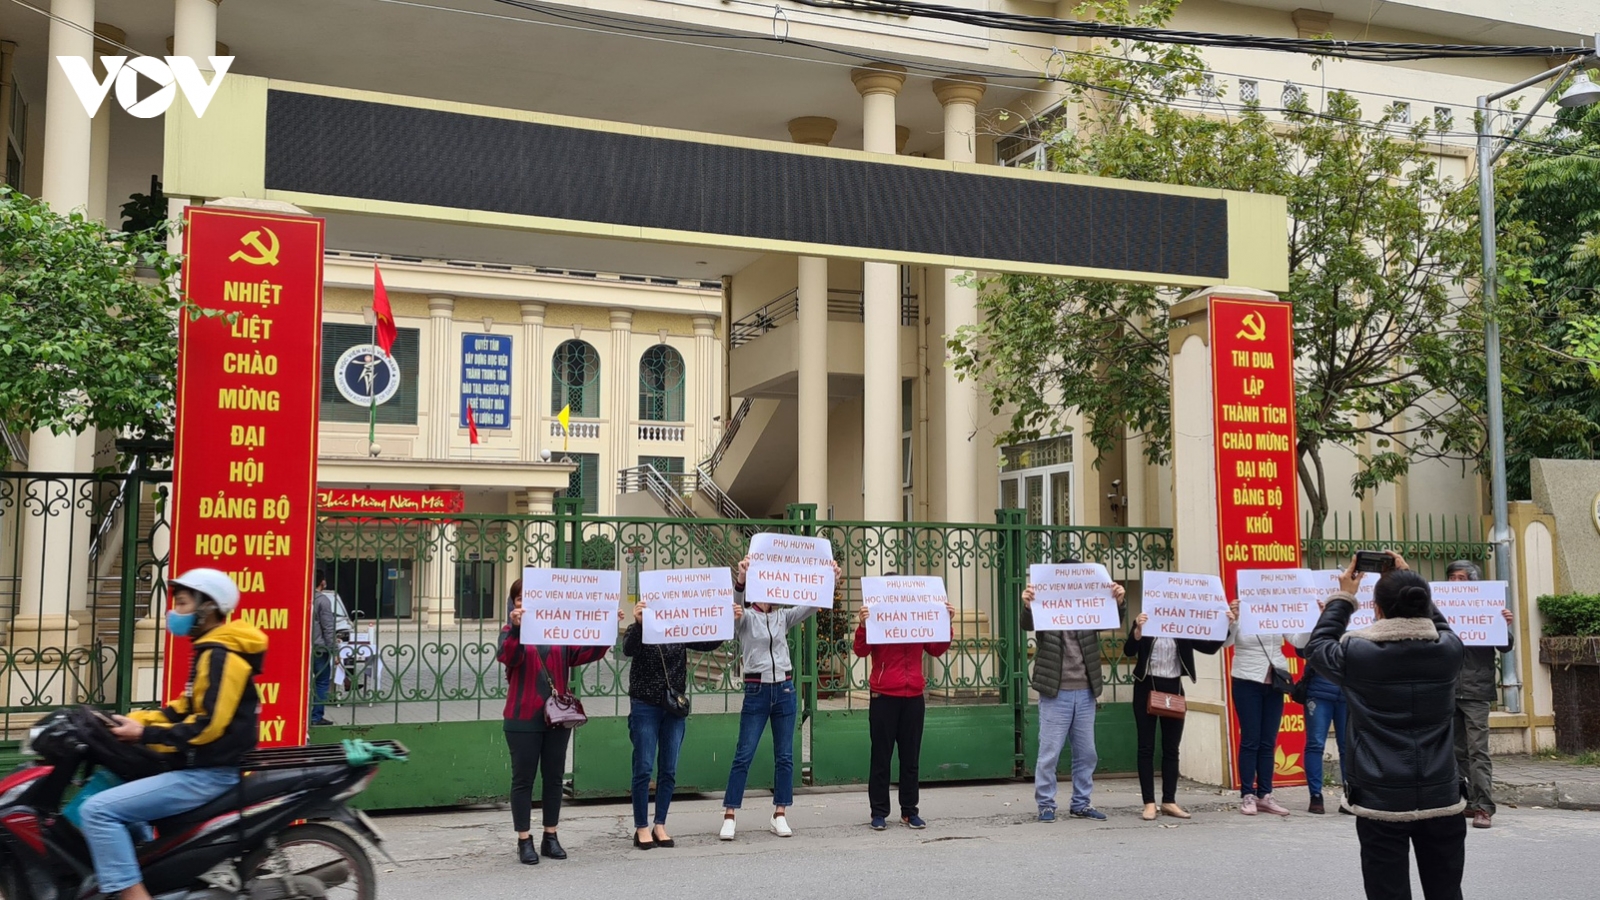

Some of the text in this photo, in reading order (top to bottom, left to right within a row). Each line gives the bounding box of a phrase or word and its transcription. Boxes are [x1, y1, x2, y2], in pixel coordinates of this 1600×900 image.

[223, 280, 282, 308] NHIỆT
[231, 314, 272, 343] LIỆT
[223, 350, 277, 375] CHÀO
[1232, 350, 1274, 369] THI ĐUA
[1243, 376, 1264, 399] LẬP
[218, 385, 280, 412] MỪNG
[1222, 402, 1287, 424] THÀNH TÍCH
[230, 425, 265, 451] ĐẠI
[1222, 430, 1289, 451] CHÀO MỪNG
[229, 457, 264, 487] HỘI
[1236, 459, 1277, 480] ĐẠI HỘI
[1233, 483, 1282, 509] ĐẢNG BỘ
[199, 491, 290, 524] ĐẢNG BỘ
[390, 495, 418, 511] Năm
[1246, 512, 1272, 534] KHỐI
[195, 531, 290, 560] HỌC VIỆN
[773, 539, 815, 550] PHỤ HUYNH
[1226, 542, 1295, 563] CÁC TRƯỜNG
[766, 554, 783, 563] VIỆN
[784, 554, 800, 564] MÚA
[802, 557, 817, 566] VIỆT
[552, 574, 598, 585] PHỤ HUYNH
[667, 574, 710, 584] PHỤ HUYNH
[794, 573, 824, 584] THIẾT
[1055, 569, 1070, 578] PHỤ
[1261, 574, 1274, 582] PHỤ
[887, 581, 901, 589] PHỤ
[1049, 583, 1066, 592] VIỆN
[1084, 582, 1099, 591] VIỆT
[1168, 577, 1209, 586] PHỤ HUYNH
[525, 590, 542, 599] HỌC
[545, 590, 563, 600] VIỆN
[566, 590, 583, 600] MÚA
[586, 591, 603, 602] VIỆT
[642, 592, 659, 602] HỌC
[662, 590, 679, 600] VIỆN
[682, 588, 698, 597] MÚA
[700, 588, 716, 599] VIỆT
[767, 586, 817, 600] KÊU CỨU
[1145, 590, 1160, 598] HỌC
[1163, 591, 1179, 600] VIỆN
[1198, 593, 1212, 602] VIỆT
[1215, 594, 1224, 602] NA
[1240, 588, 1255, 597] HỌC
[1256, 588, 1271, 597] VIỆN
[1434, 586, 1449, 594] PHỤ
[883, 594, 899, 604] VIỆN
[917, 594, 931, 603] VIỆT
[1075, 596, 1105, 607] THIẾT
[1468, 600, 1484, 608] VIỆT
[693, 605, 724, 617] THIẾT
[1281, 602, 1308, 612] THIẾT
[241, 608, 288, 629] NAM
[575, 609, 609, 621] THIẾT
[910, 609, 939, 620] THIẾT
[1052, 613, 1100, 625] KÊU CỨU
[1189, 608, 1219, 619] THIẾT
[1460, 614, 1494, 624] THIẾT
[1161, 622, 1211, 635] KÊU CỨU
[1259, 617, 1304, 629] KÊU CỨU
[544, 626, 600, 639] KÊU CỨU
[665, 623, 717, 637] KÊU CỨU
[885, 626, 933, 638] KÊU CỨU
[1460, 630, 1486, 640] CỨU
[259, 715, 286, 742] KỲ
[1279, 715, 1305, 732] 2025
